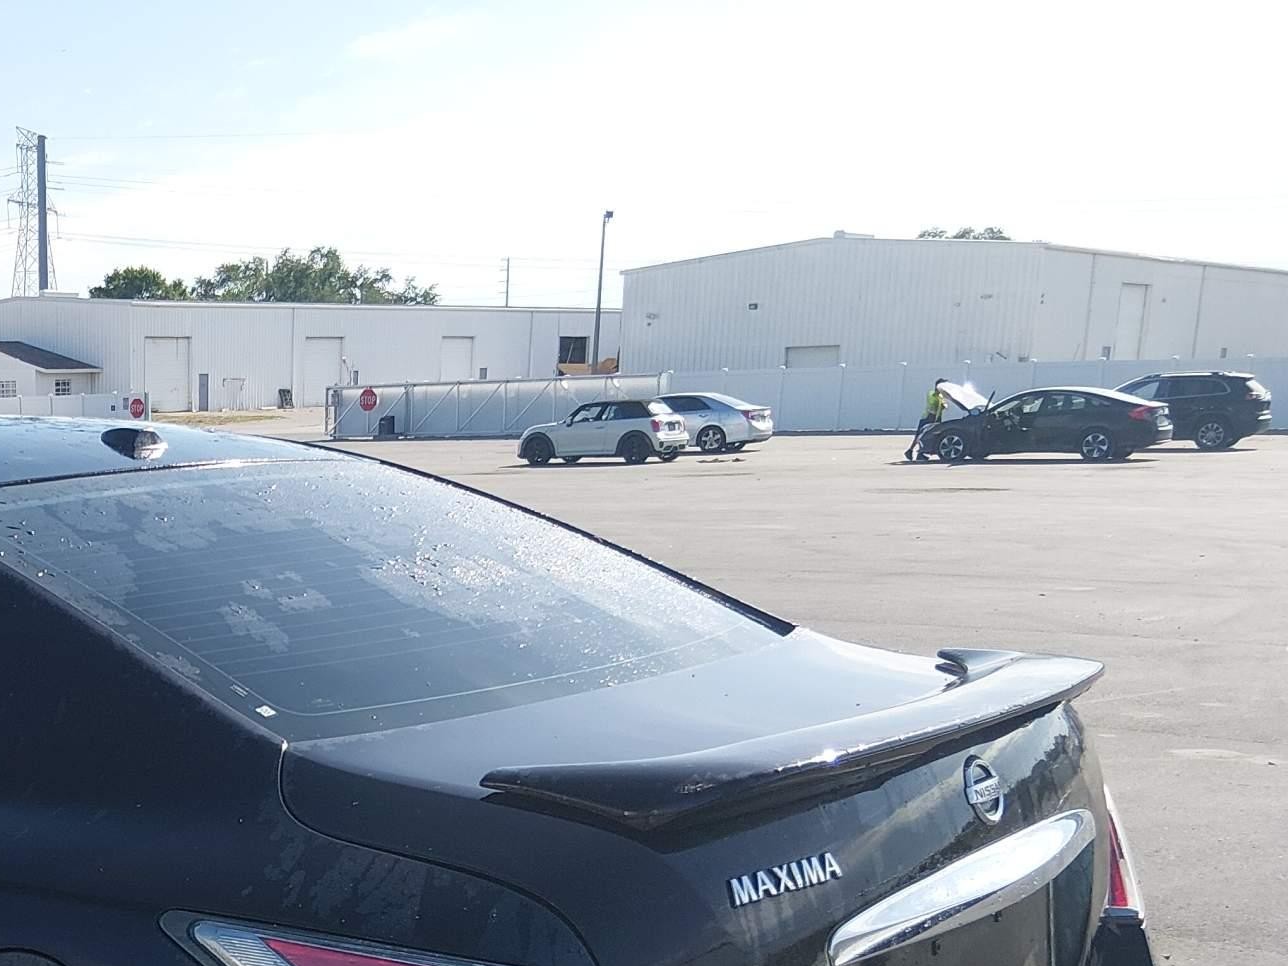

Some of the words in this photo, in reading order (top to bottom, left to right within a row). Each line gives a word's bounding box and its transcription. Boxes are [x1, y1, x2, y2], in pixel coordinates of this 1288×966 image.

[360, 395, 376, 405] STOP
[131, 404, 143, 413] STOP
[728, 851, 843, 908] MAXIMA
